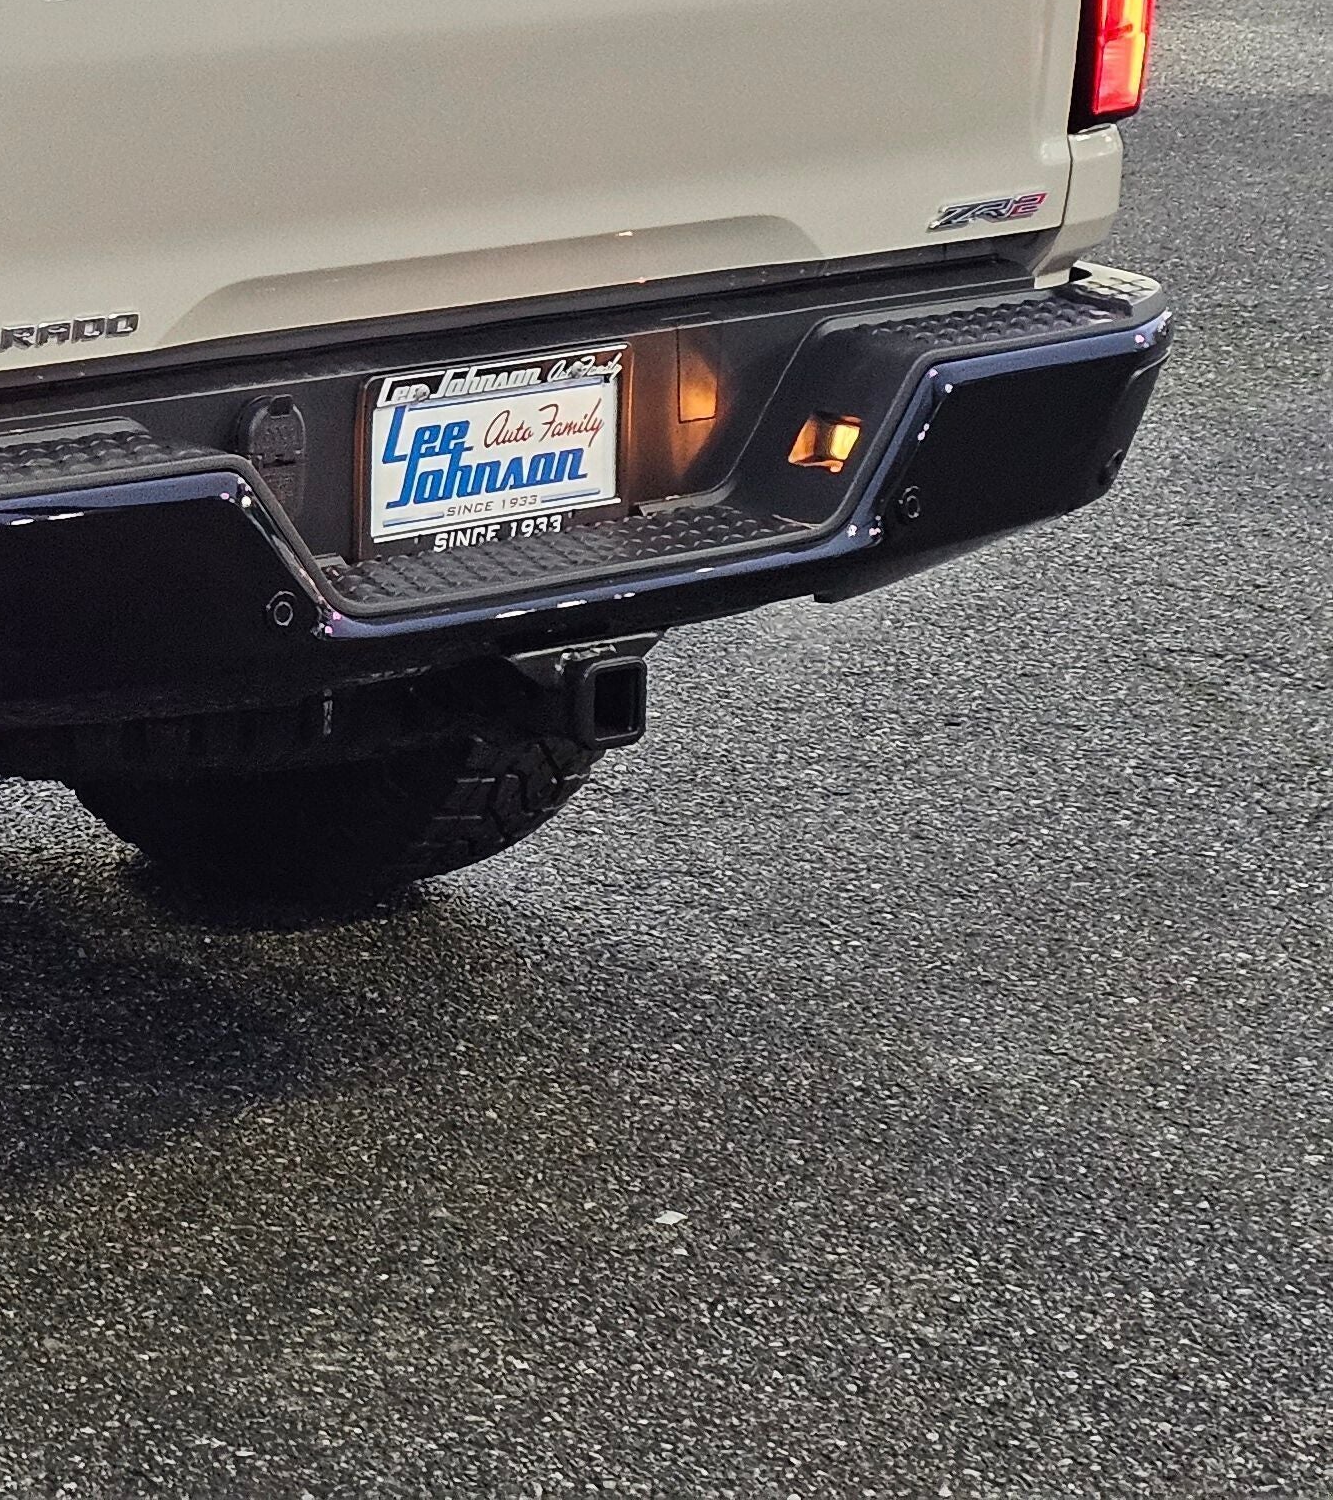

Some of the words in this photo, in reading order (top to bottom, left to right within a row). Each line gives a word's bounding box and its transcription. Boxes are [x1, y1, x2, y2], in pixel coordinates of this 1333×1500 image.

[927, 191, 1049, 232] ZR2
[429, 365, 542, 400] Johnson
[383, 405, 473, 464] Lee
[484, 409, 534, 449] Auto
[538, 398, 605, 449] Family
[386, 443, 588, 509] Johnson
[446, 500, 495, 517] SINCE
[501, 494, 539, 510] 1933
